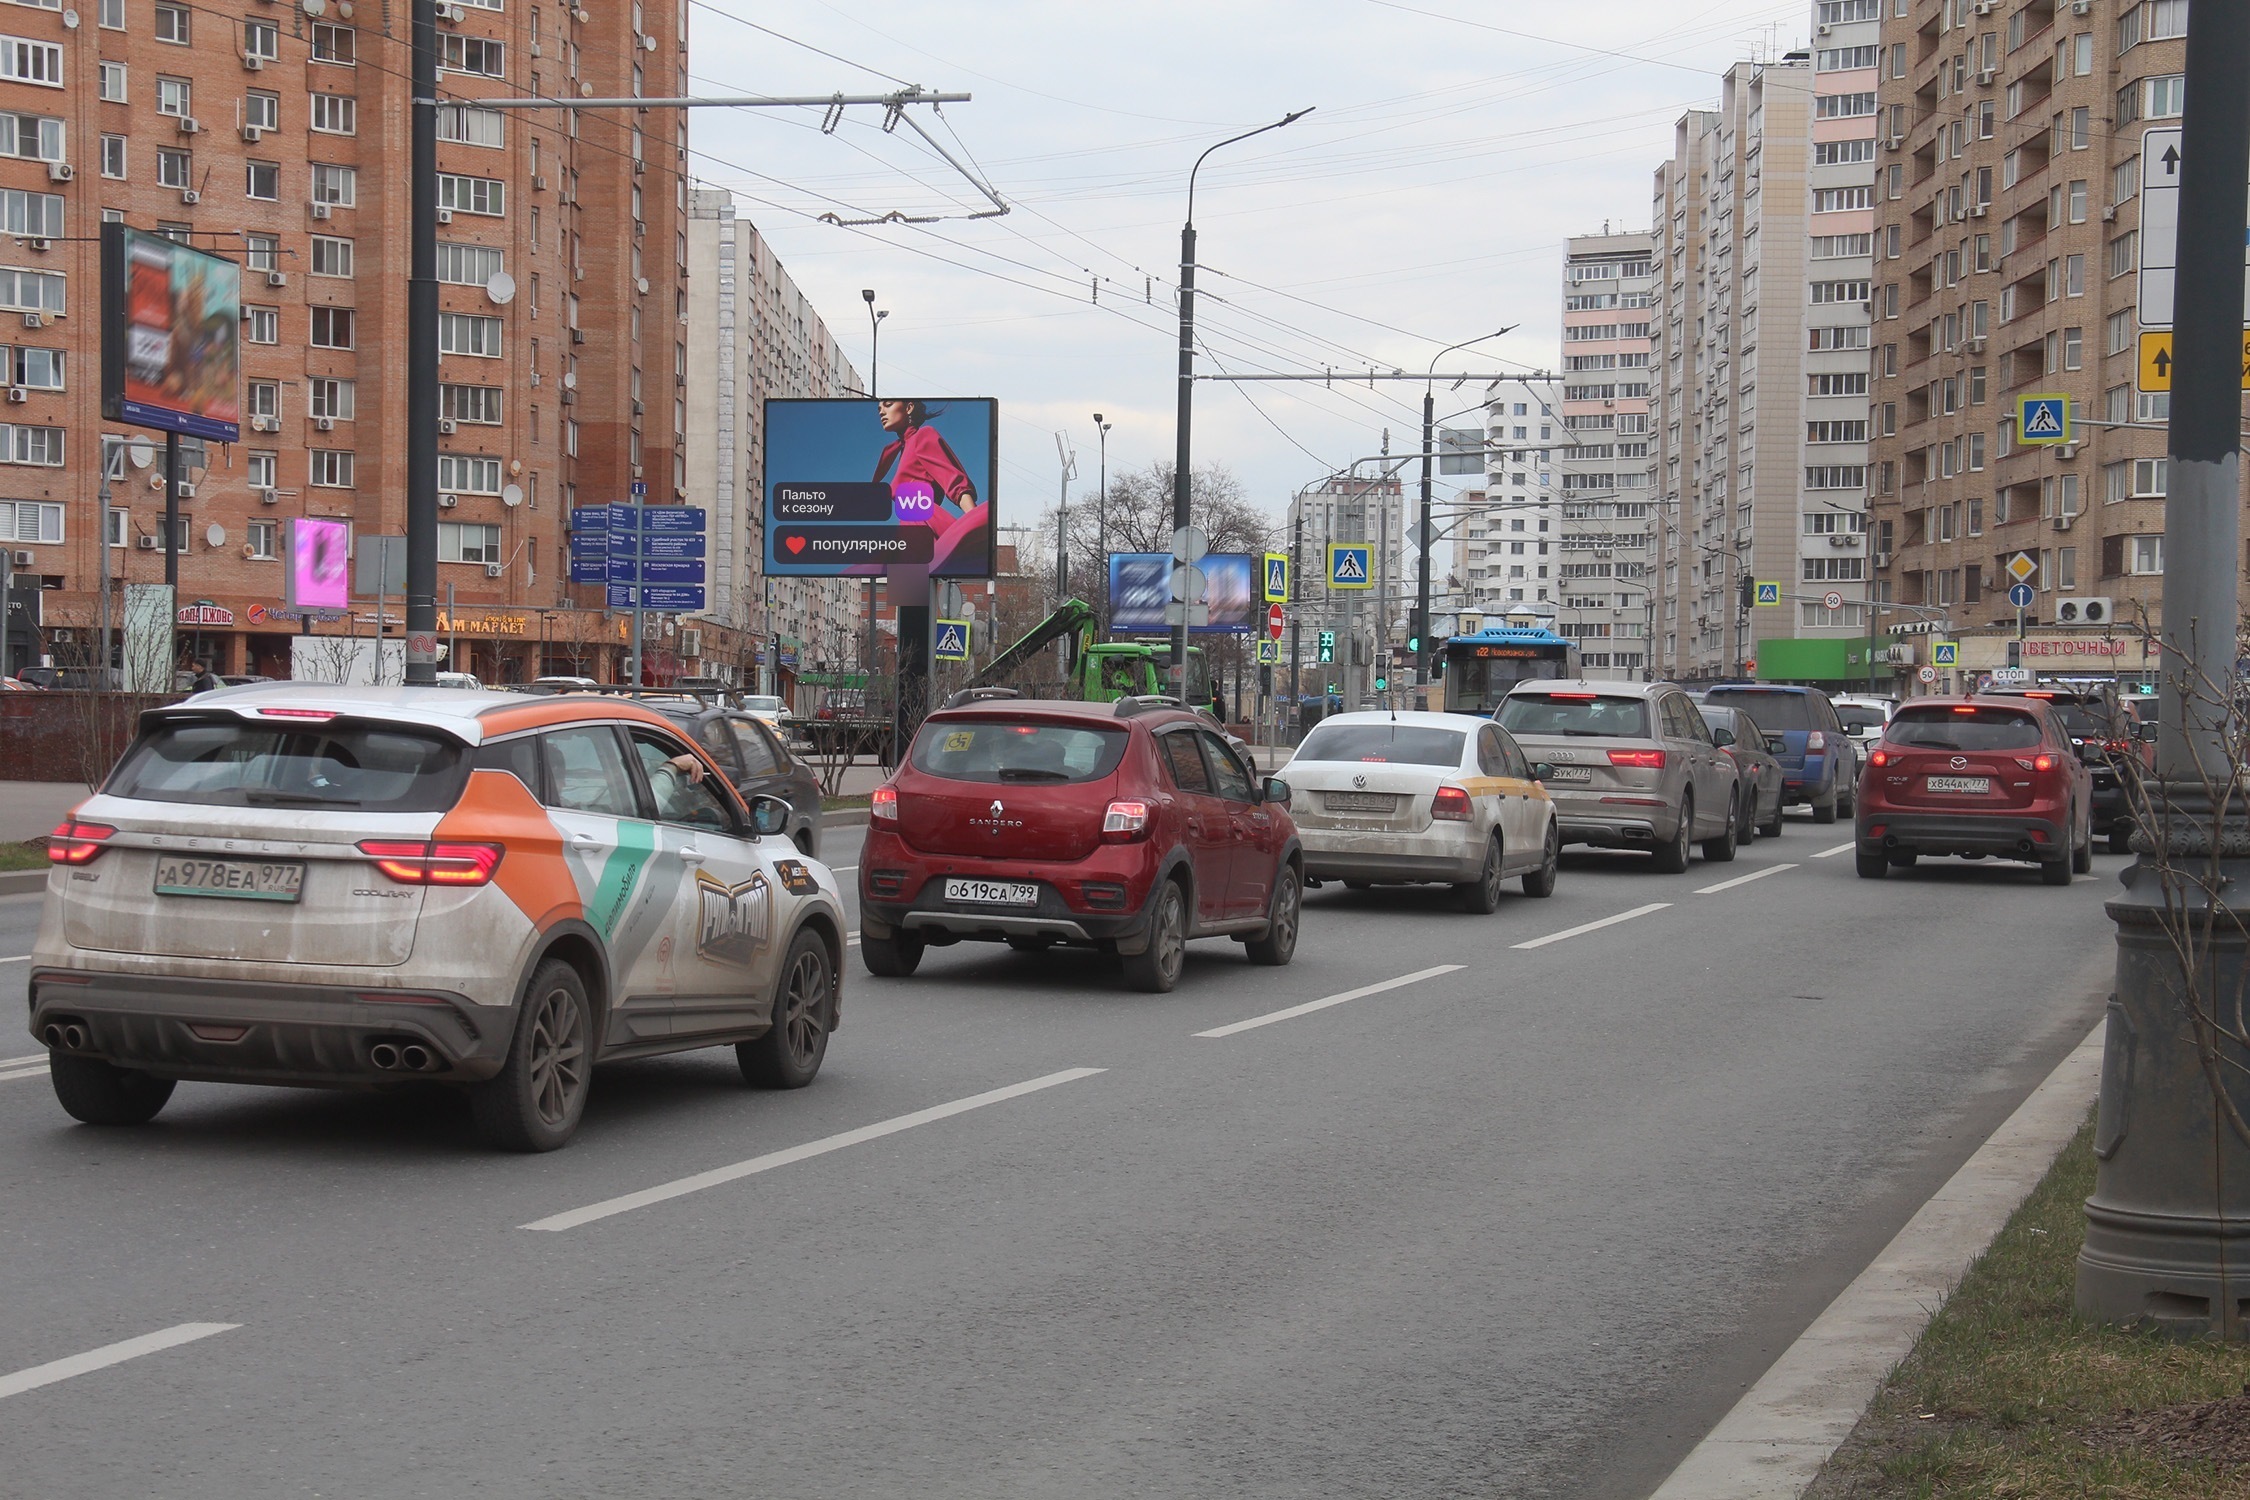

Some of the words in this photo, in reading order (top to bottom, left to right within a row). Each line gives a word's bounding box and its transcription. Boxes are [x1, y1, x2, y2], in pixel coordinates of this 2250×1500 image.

[782, 489, 826, 501] Пальто
[897, 490, 932, 510] wb
[782, 504, 790, 513] к
[792, 504, 834, 515] сезону
[812, 538, 907, 553] популярное
[1827, 596, 1839, 605] 50
[202, 607, 233, 623] ДЖОНС
[1320, 632, 1334, 647] 39
[1922, 670, 1933, 679] 50
[1997, 670, 2025, 679] СТОП
[1931, 778, 1969, 789] Х844АК
[1971, 779, 1987, 787] 777
[969, 818, 1023, 827] SANDERO
[152, 836, 307, 852] GEELY
[163, 861, 255, 890] А978ЕА
[262, 865, 298, 885] 977
[353, 889, 415, 899] COOLRAY
[949, 881, 1008, 901] О619СА
[1011, 885, 1035, 899] 799
[604, 863, 637, 938] делимобиль
